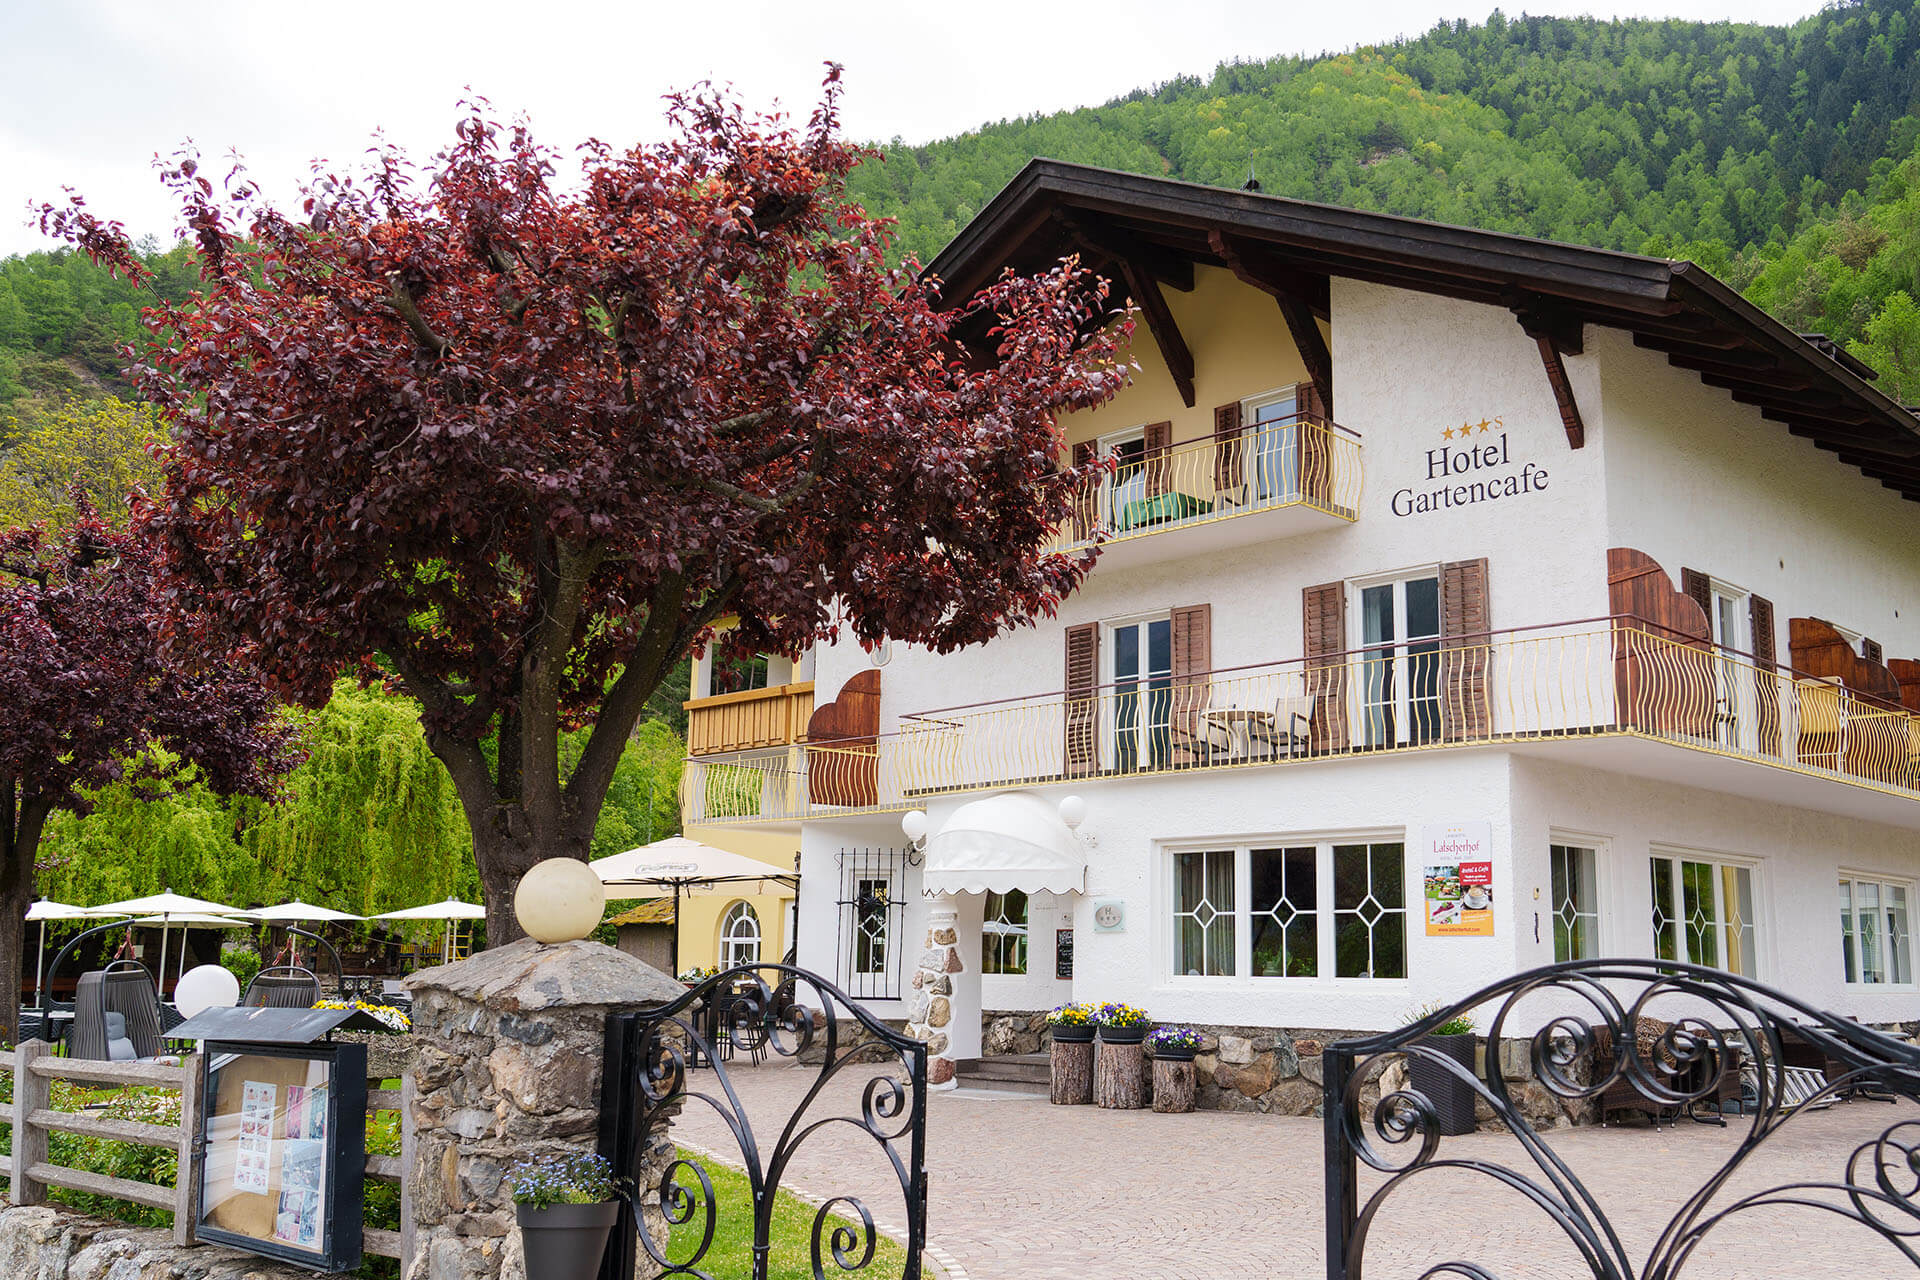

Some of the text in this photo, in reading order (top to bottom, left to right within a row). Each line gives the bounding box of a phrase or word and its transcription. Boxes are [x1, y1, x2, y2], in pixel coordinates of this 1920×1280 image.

[1494, 415, 1504, 430] S
[1425, 433, 1510, 480] Hotel
[1391, 463, 1549, 517] Gartencafe
